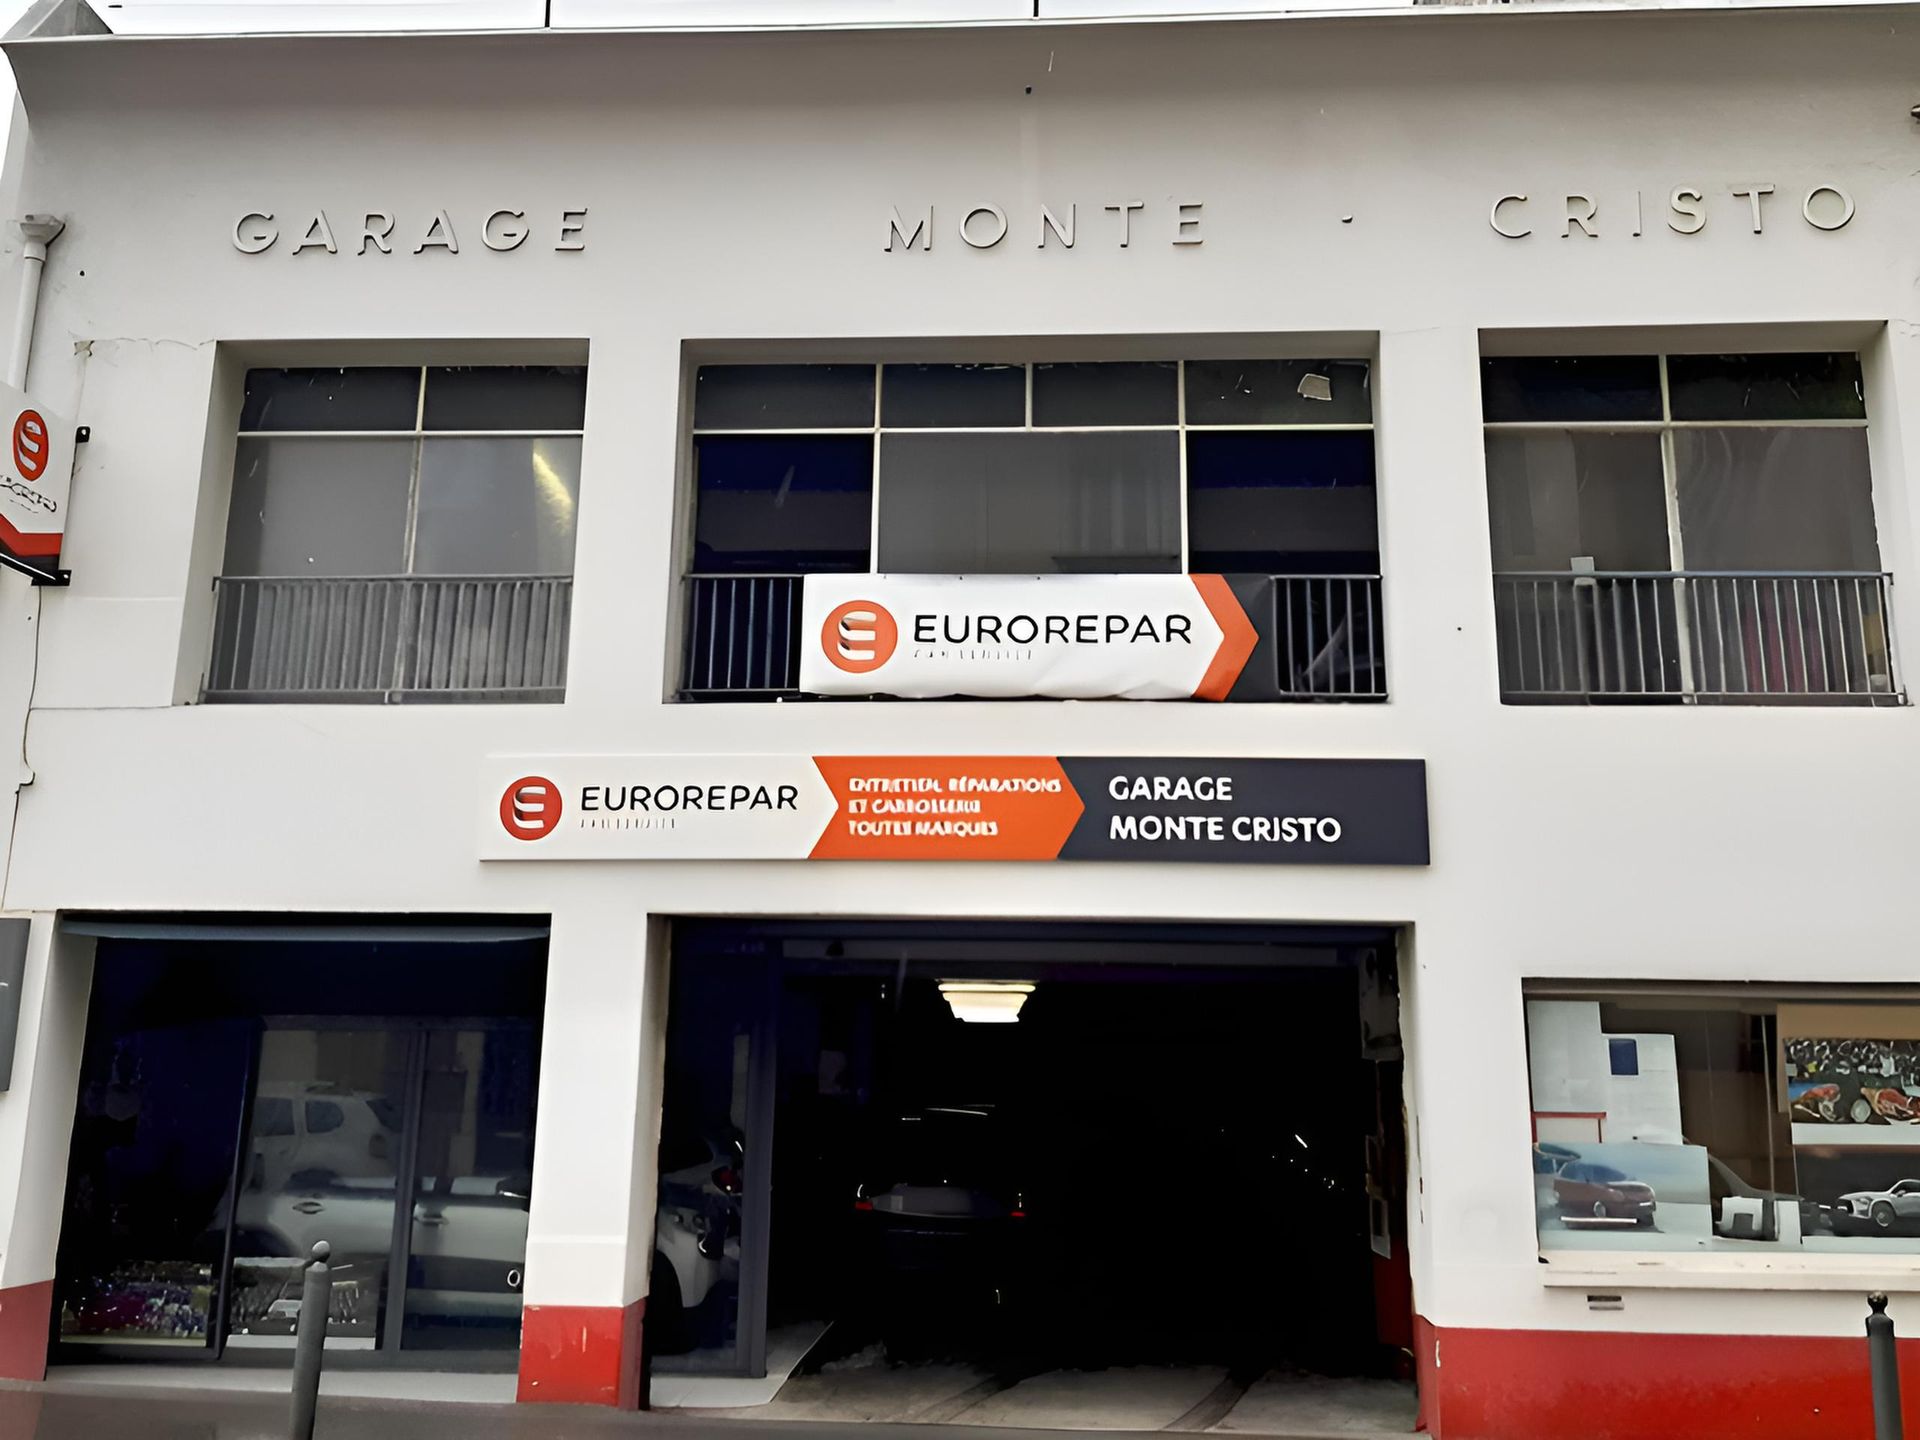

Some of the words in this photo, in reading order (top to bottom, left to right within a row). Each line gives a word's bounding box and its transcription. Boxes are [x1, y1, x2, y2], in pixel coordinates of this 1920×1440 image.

[232, 208, 588, 255] GARAGE
[884, 202, 1204, 252] MONTE
[1490, 184, 1855, 238] CRISTO
[914, 614, 1191, 644] EUROREPAR
[581, 785, 798, 811] EUROREPAR
[1109, 776, 1233, 800] GARAGE
[1110, 815, 1225, 841] MONTE
[1232, 817, 1342, 843] CRISTO
